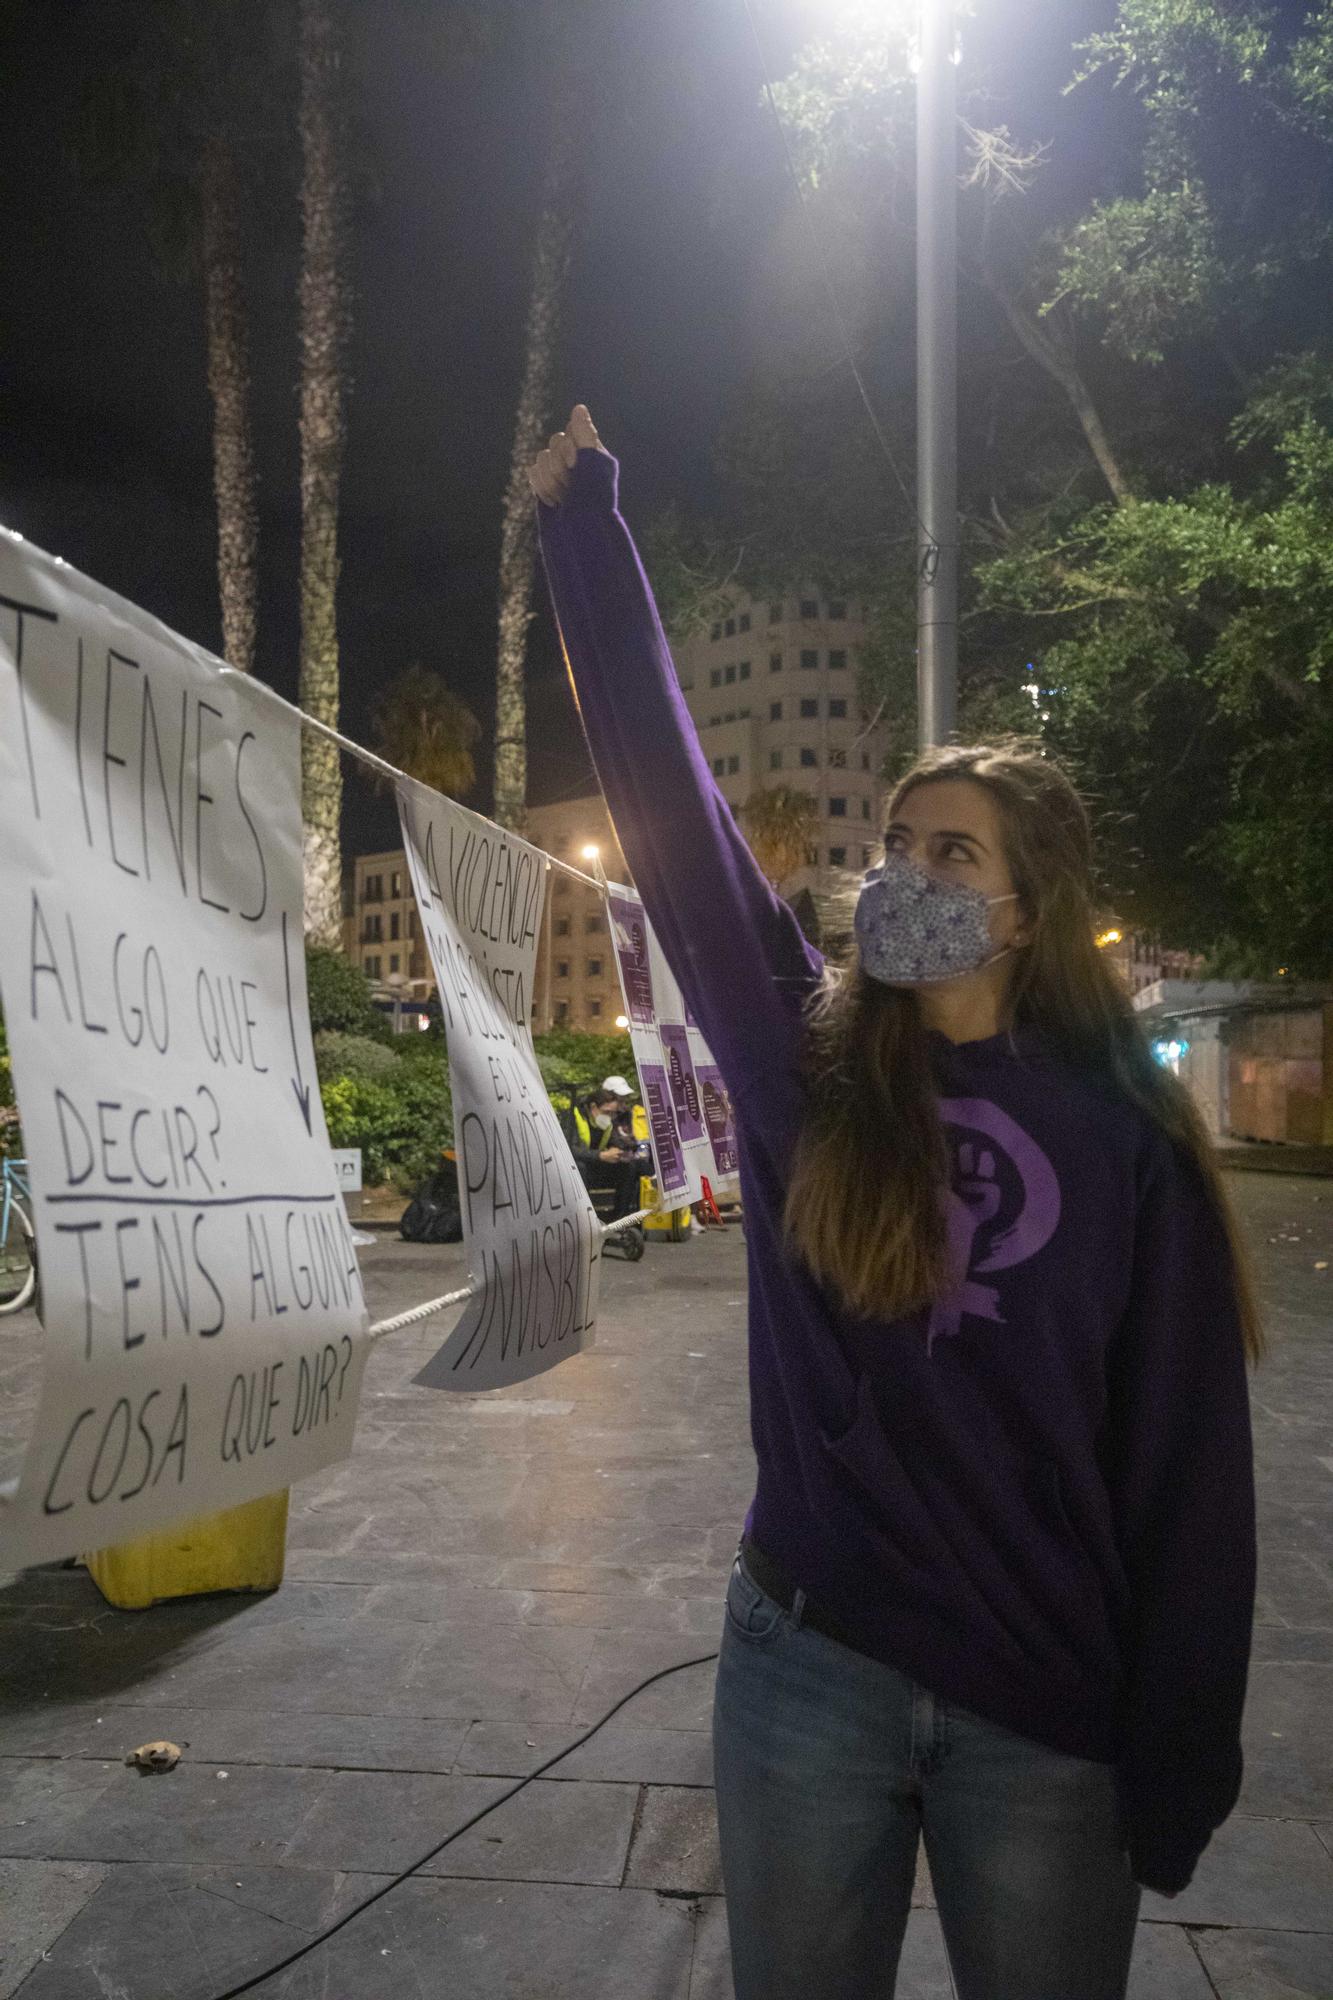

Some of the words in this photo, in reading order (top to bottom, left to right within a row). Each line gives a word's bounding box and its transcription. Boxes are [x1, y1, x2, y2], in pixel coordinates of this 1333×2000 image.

[0, 594, 268, 922] TIENES
[403, 802, 442, 911] LA
[30, 886, 169, 1055] ALGO
[198, 966, 269, 1074] QUE
[55, 1085, 229, 1194] DECIR?
[54, 1212, 226, 1361] TENS
[246, 1207, 365, 1323] ALGUNA
[452, 1205, 599, 1371] INVISIBLE
[43, 1383, 189, 1516] COSA
[220, 1361, 284, 1464] QUE
[292, 1334, 353, 1437] DIR?
